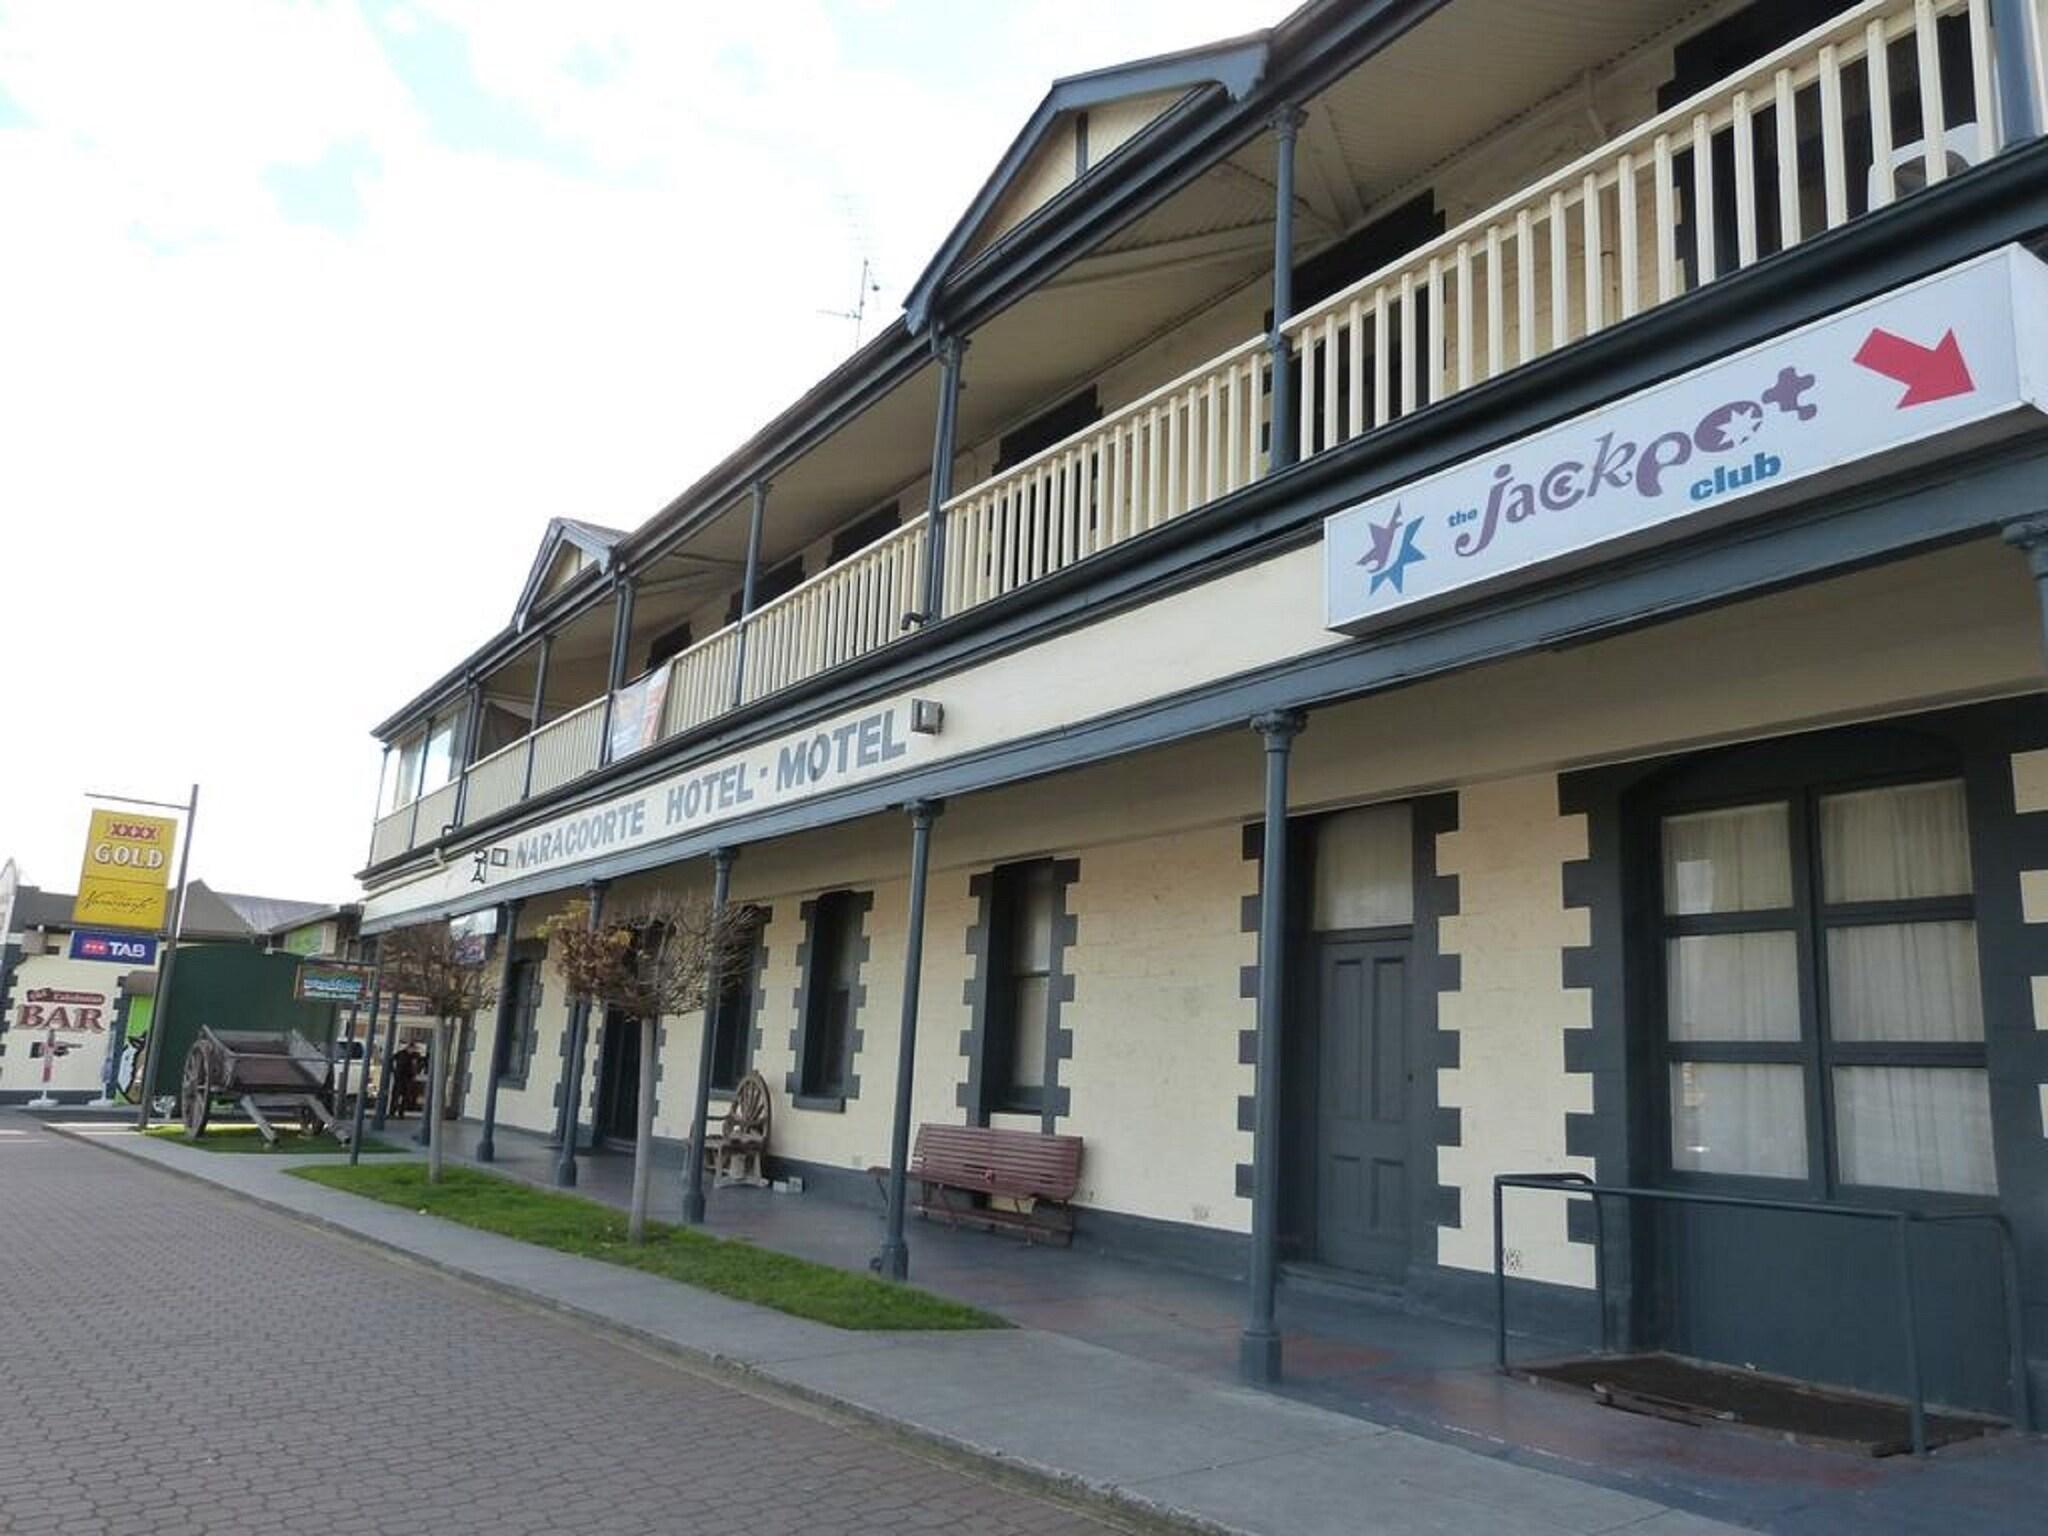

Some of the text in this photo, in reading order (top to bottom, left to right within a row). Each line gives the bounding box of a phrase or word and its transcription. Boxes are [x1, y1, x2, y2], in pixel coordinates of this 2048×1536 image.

[1447, 366, 1818, 557] the jackpot
[1690, 451, 1782, 502] club
[515, 799, 646, 869] NARACOORTE
[665, 762, 753, 826] HOTEL
[776, 709, 906, 792] MOTEL
[111, 823, 157, 840] XXXX
[95, 843, 164, 870] GOLD
[109, 941, 145, 957] TAB
[16, 1004, 105, 1034] BAR
